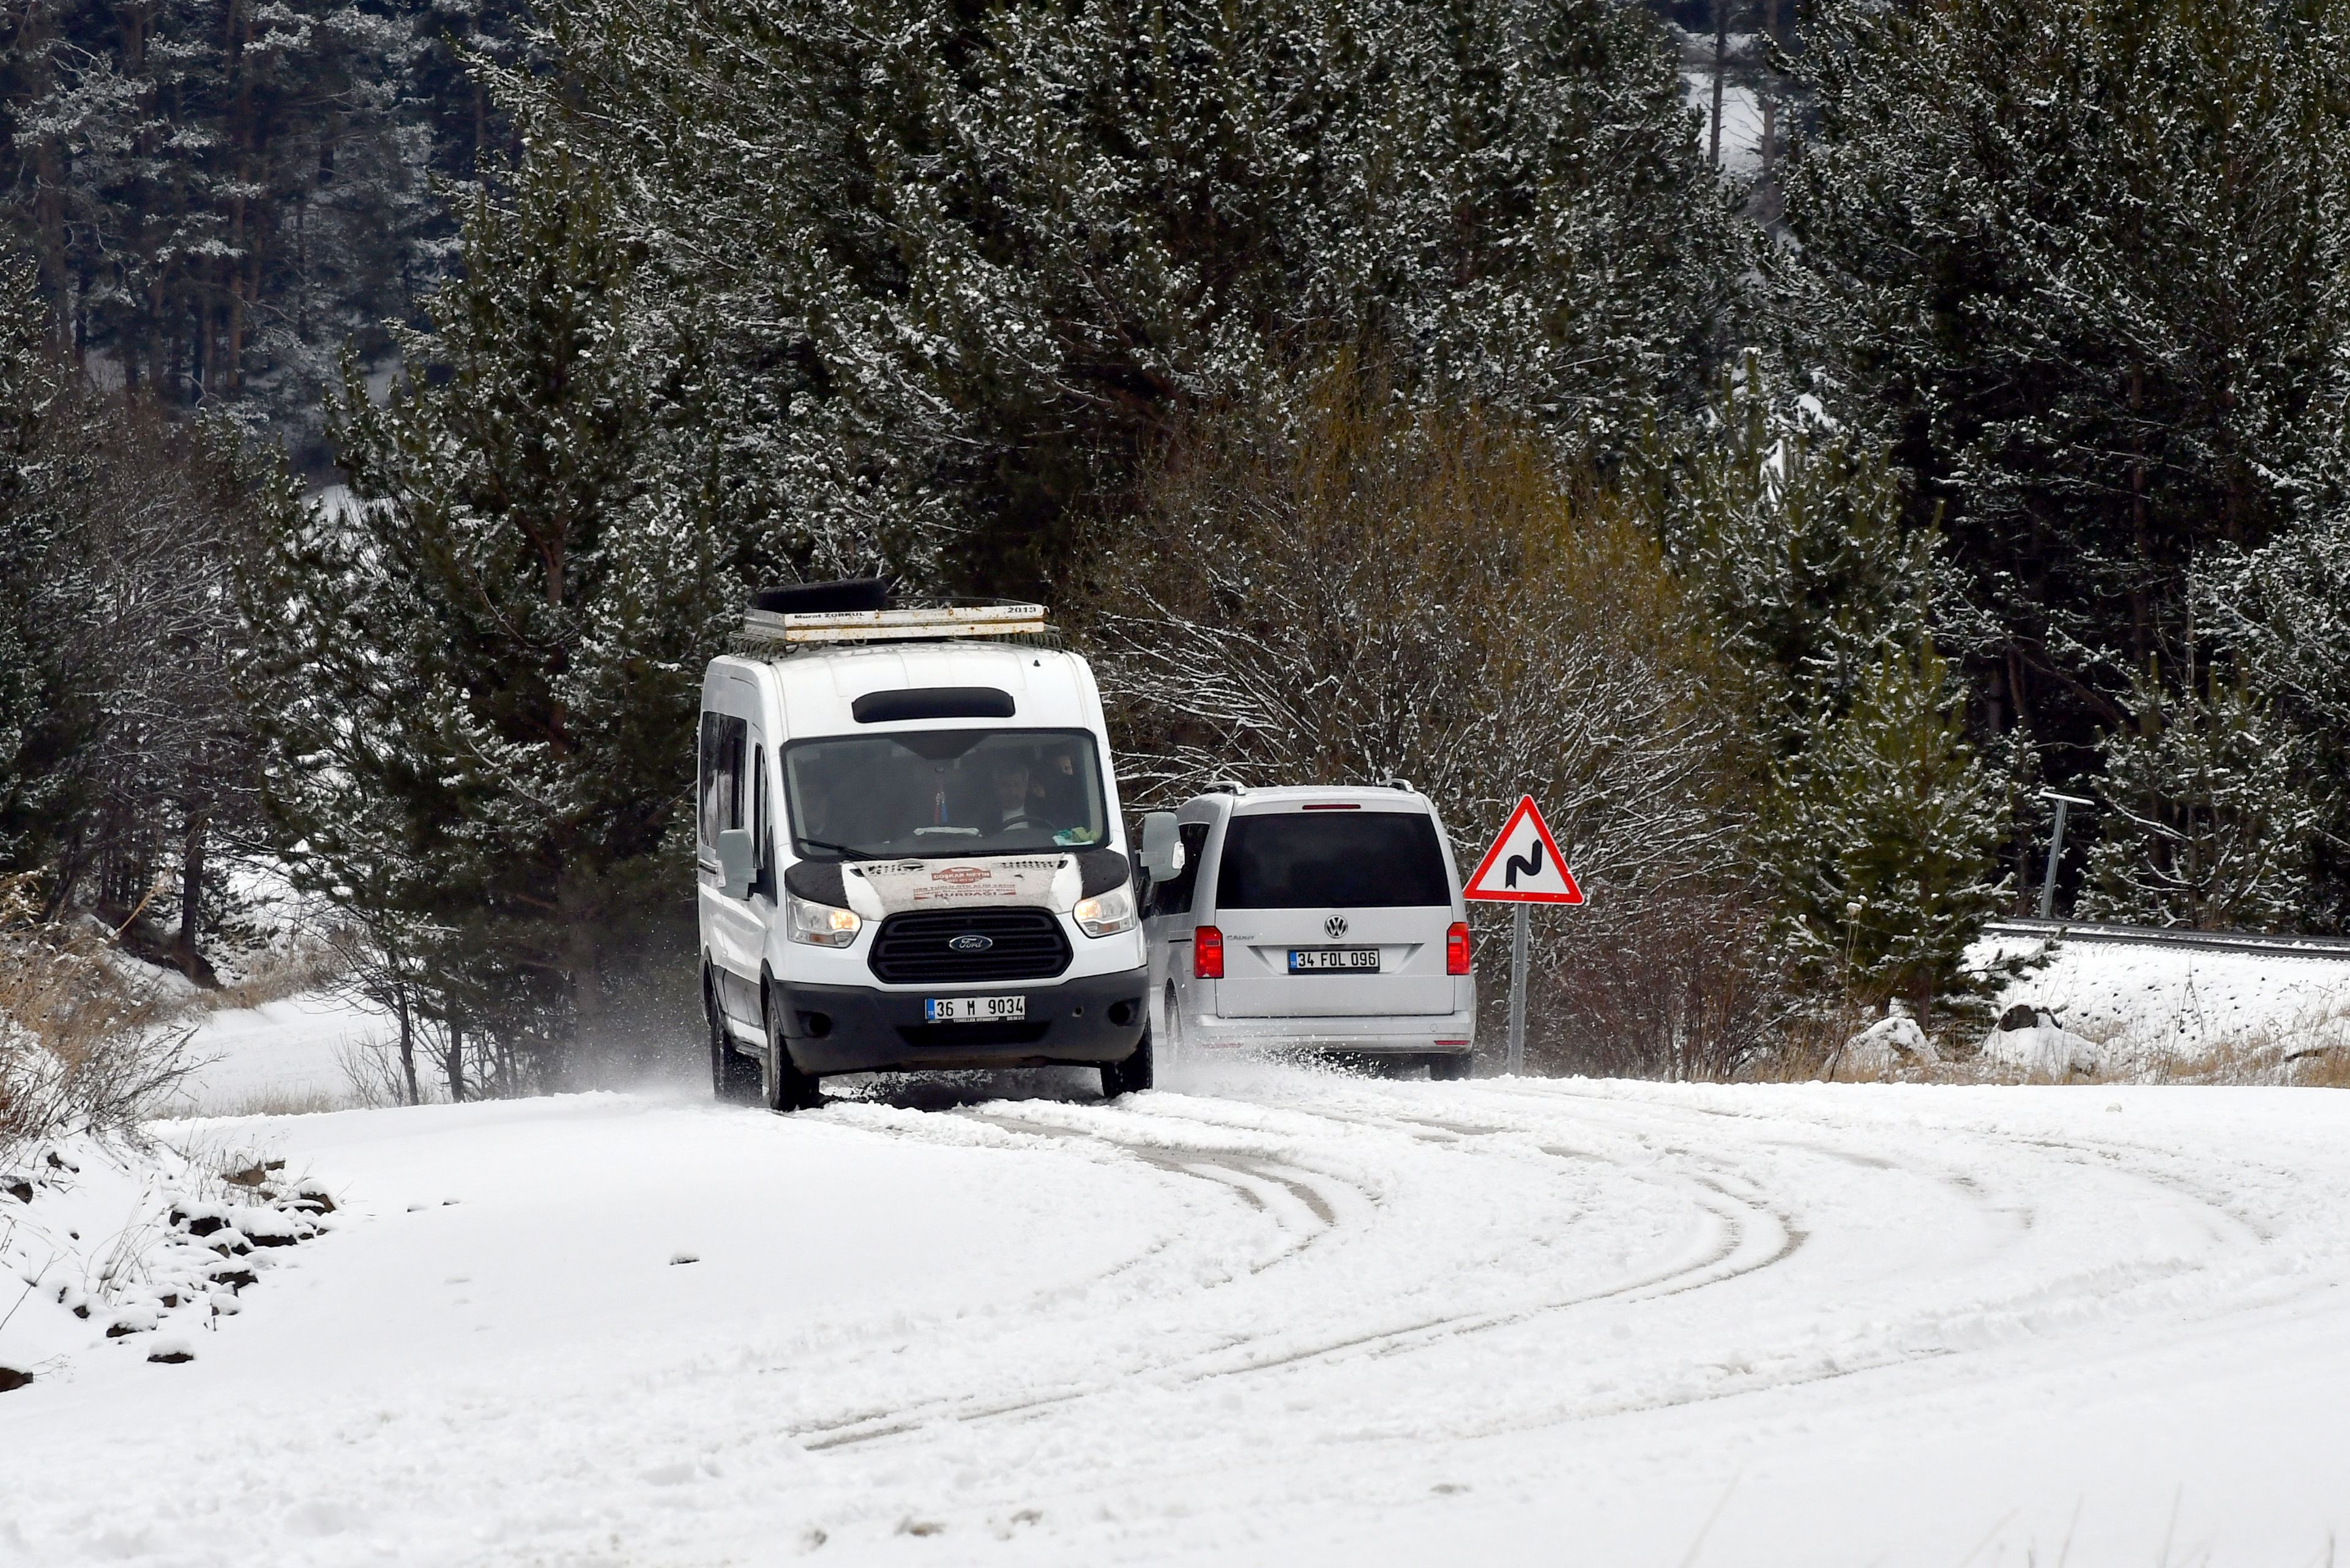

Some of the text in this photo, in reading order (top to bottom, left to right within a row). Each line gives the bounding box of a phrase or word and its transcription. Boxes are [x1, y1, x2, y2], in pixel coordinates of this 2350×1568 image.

[959, 938, 982, 948] Ford
[1298, 953, 1314, 966] 34
[1321, 952, 1346, 966] FOL
[1351, 952, 1376, 966] 096
[937, 1001, 953, 1017] 36
[967, 1000, 975, 1015] M
[988, 998, 1023, 1014] 9034
